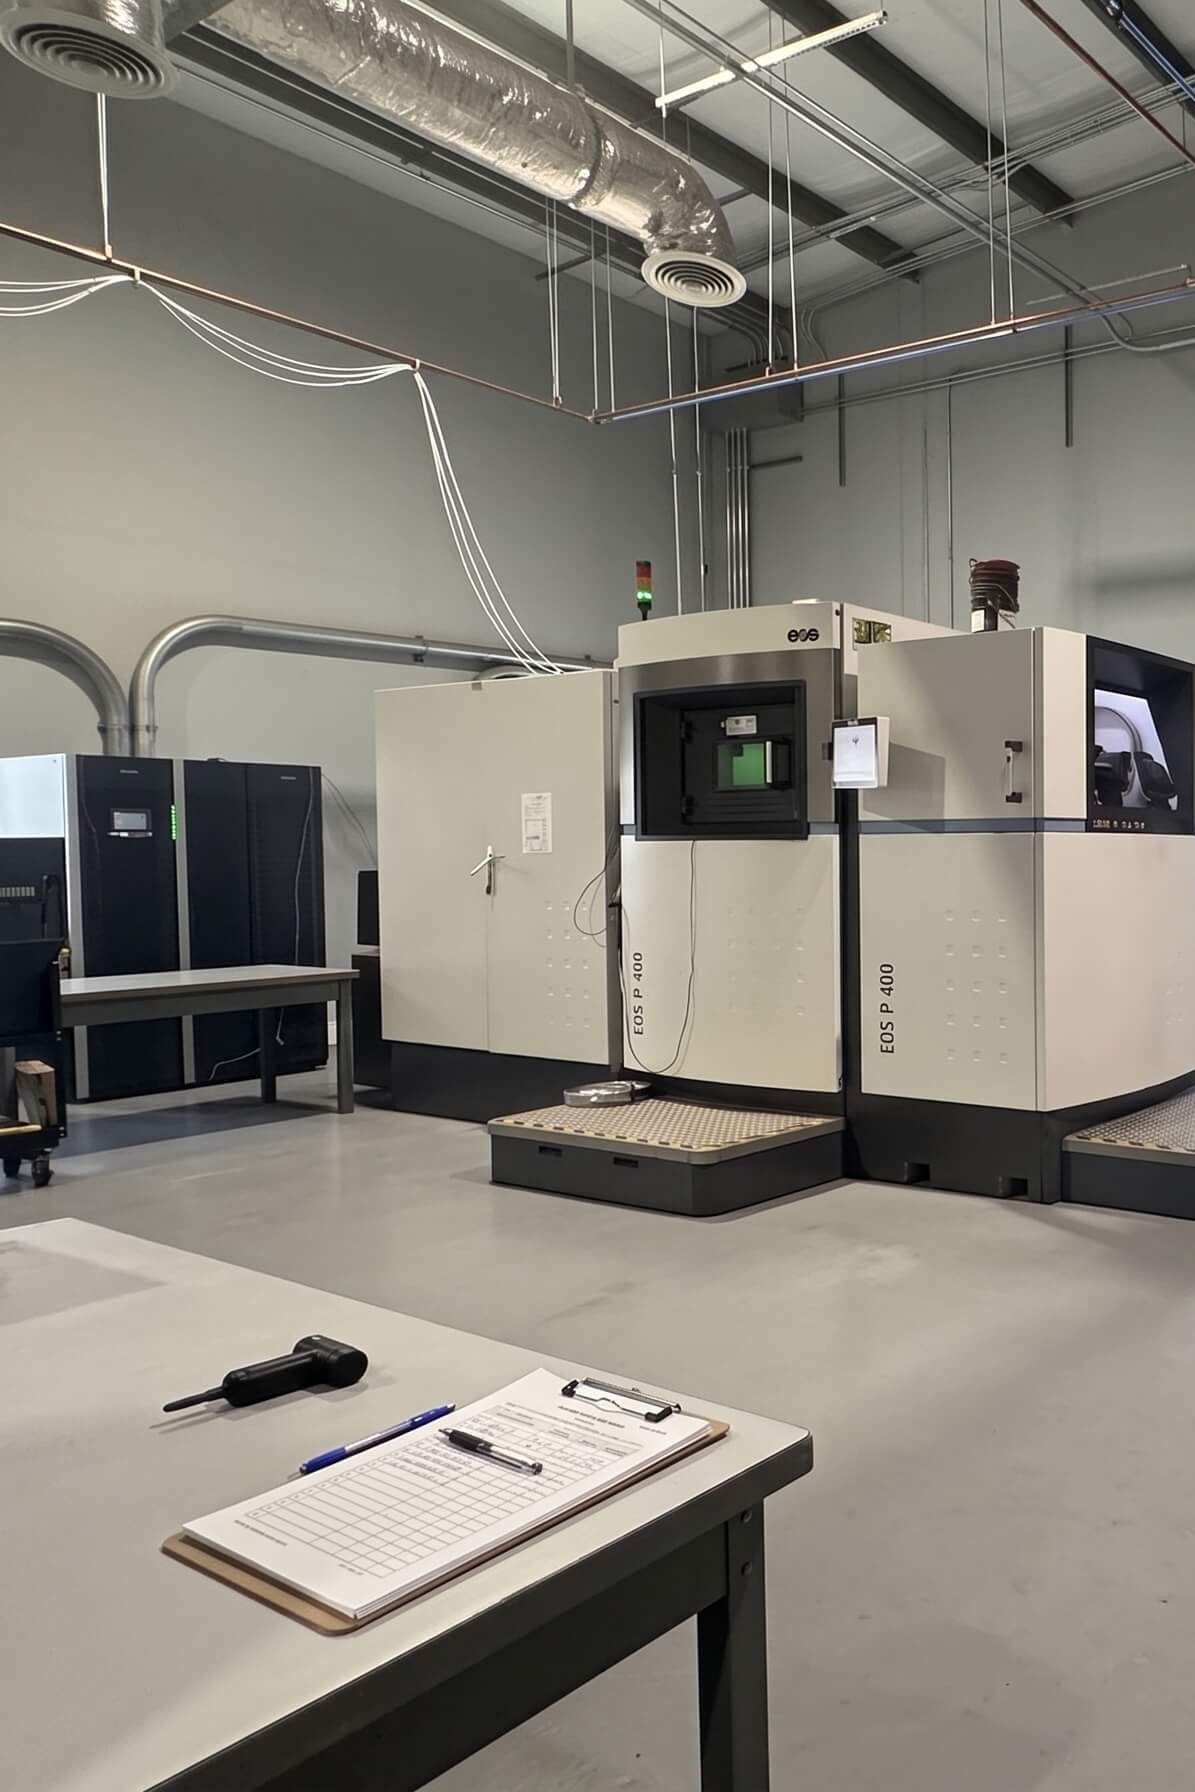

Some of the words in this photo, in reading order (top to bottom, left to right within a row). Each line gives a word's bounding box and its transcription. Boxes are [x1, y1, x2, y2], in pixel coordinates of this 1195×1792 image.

[632, 952, 643, 982] 400
[879, 963, 894, 997] 400
[633, 987, 643, 999] P
[633, 1005, 644, 1035] EOS
[880, 1003, 894, 1014] P
[880, 1021, 895, 1054] EOS
